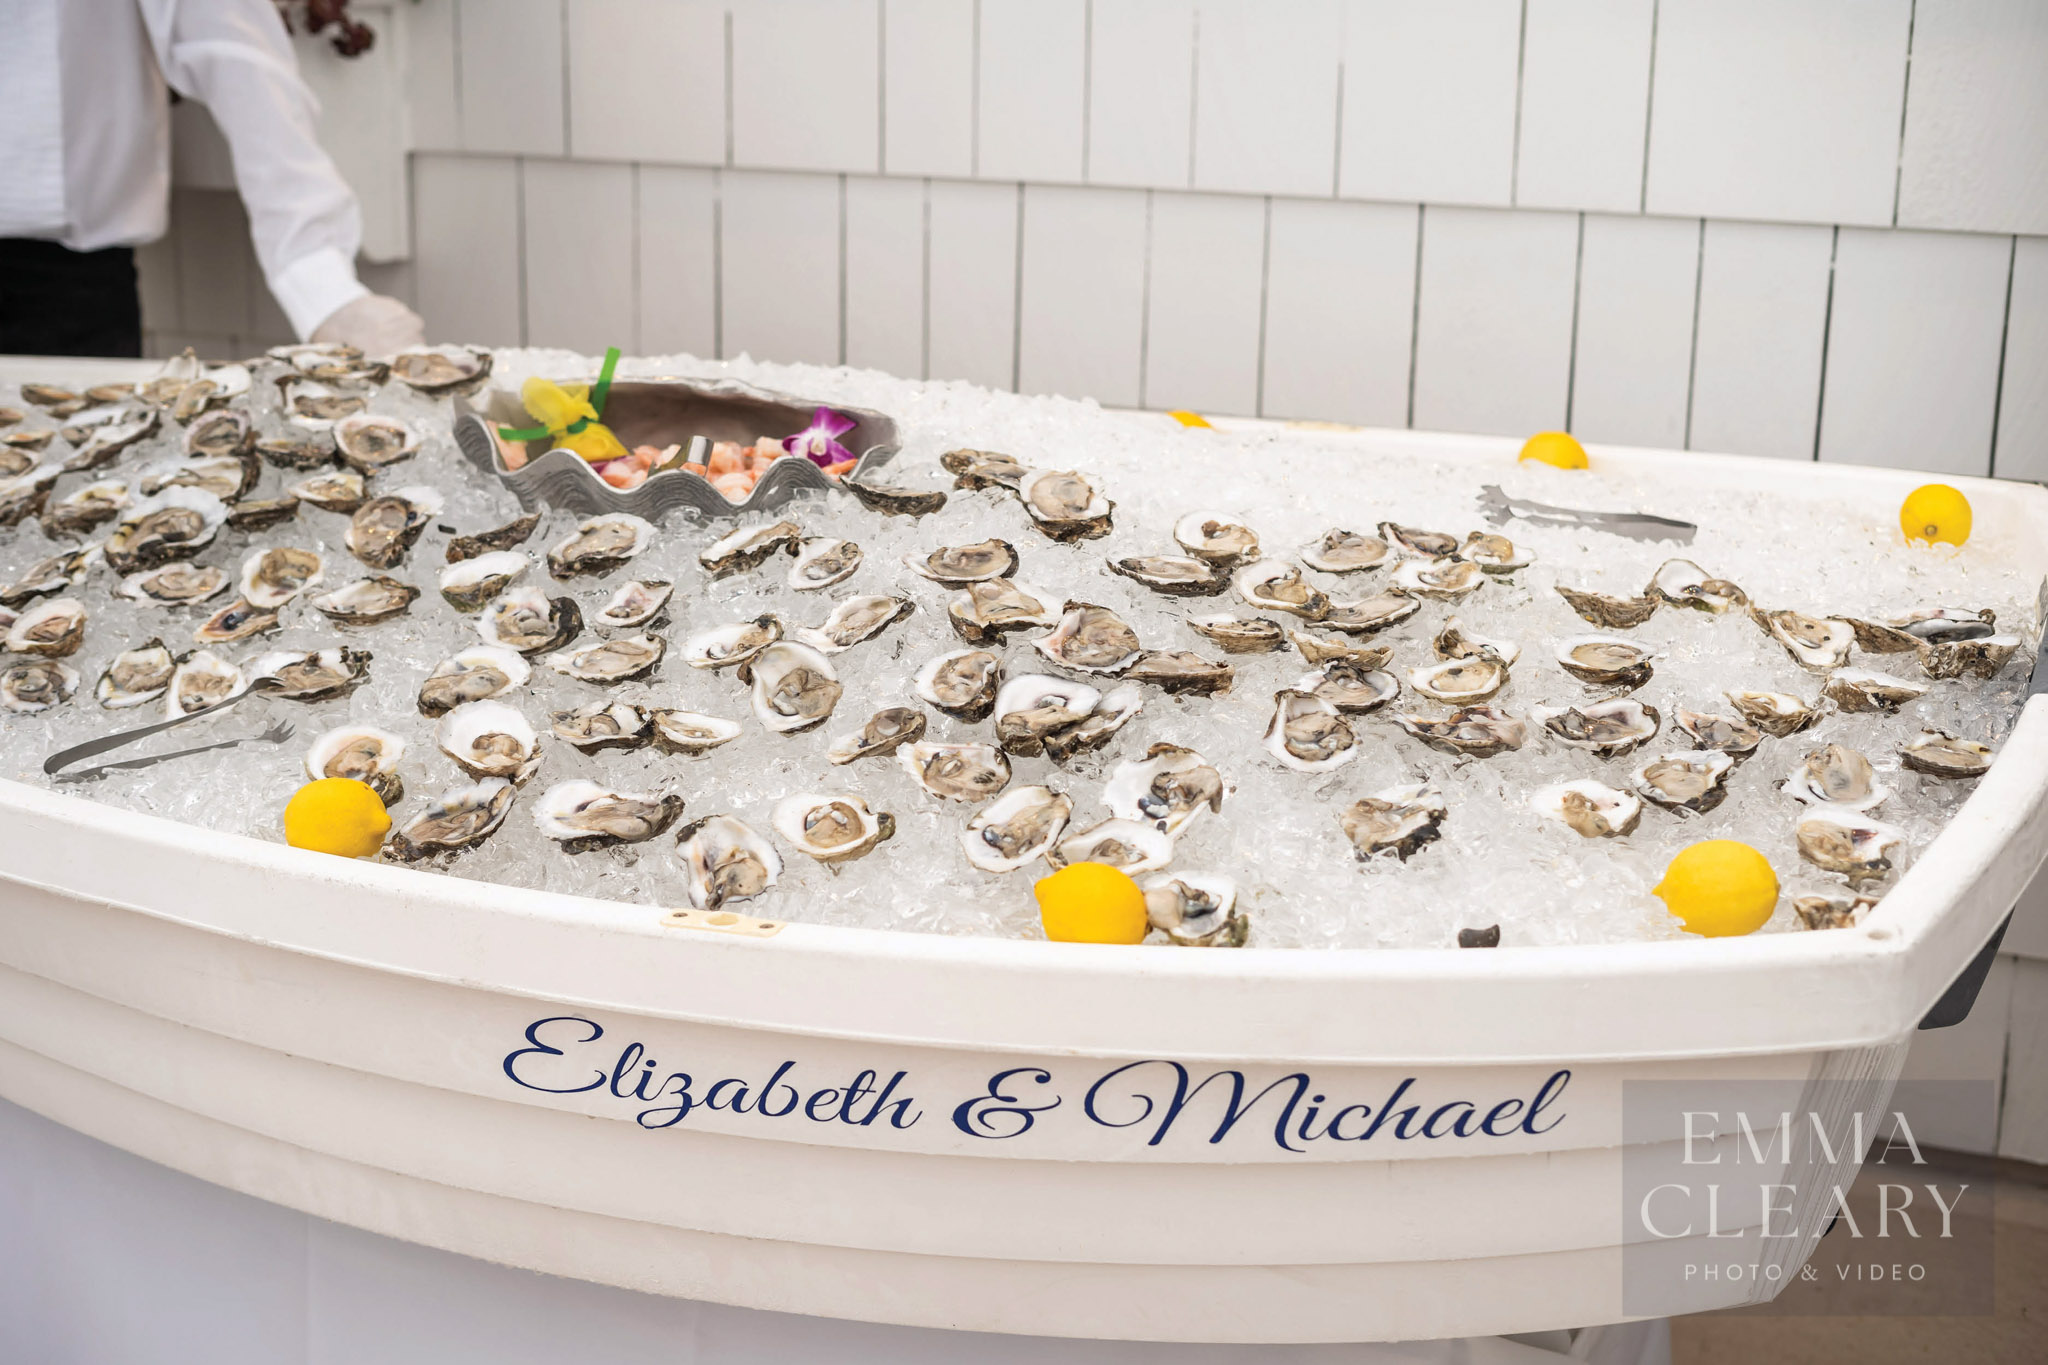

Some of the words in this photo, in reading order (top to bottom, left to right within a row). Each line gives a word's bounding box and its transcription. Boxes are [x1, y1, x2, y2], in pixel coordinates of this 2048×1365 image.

[503, 1017, 921, 1129] Elizabeth
[952, 1067, 1062, 1139] &
[1086, 1060, 1571, 1153] Michael
